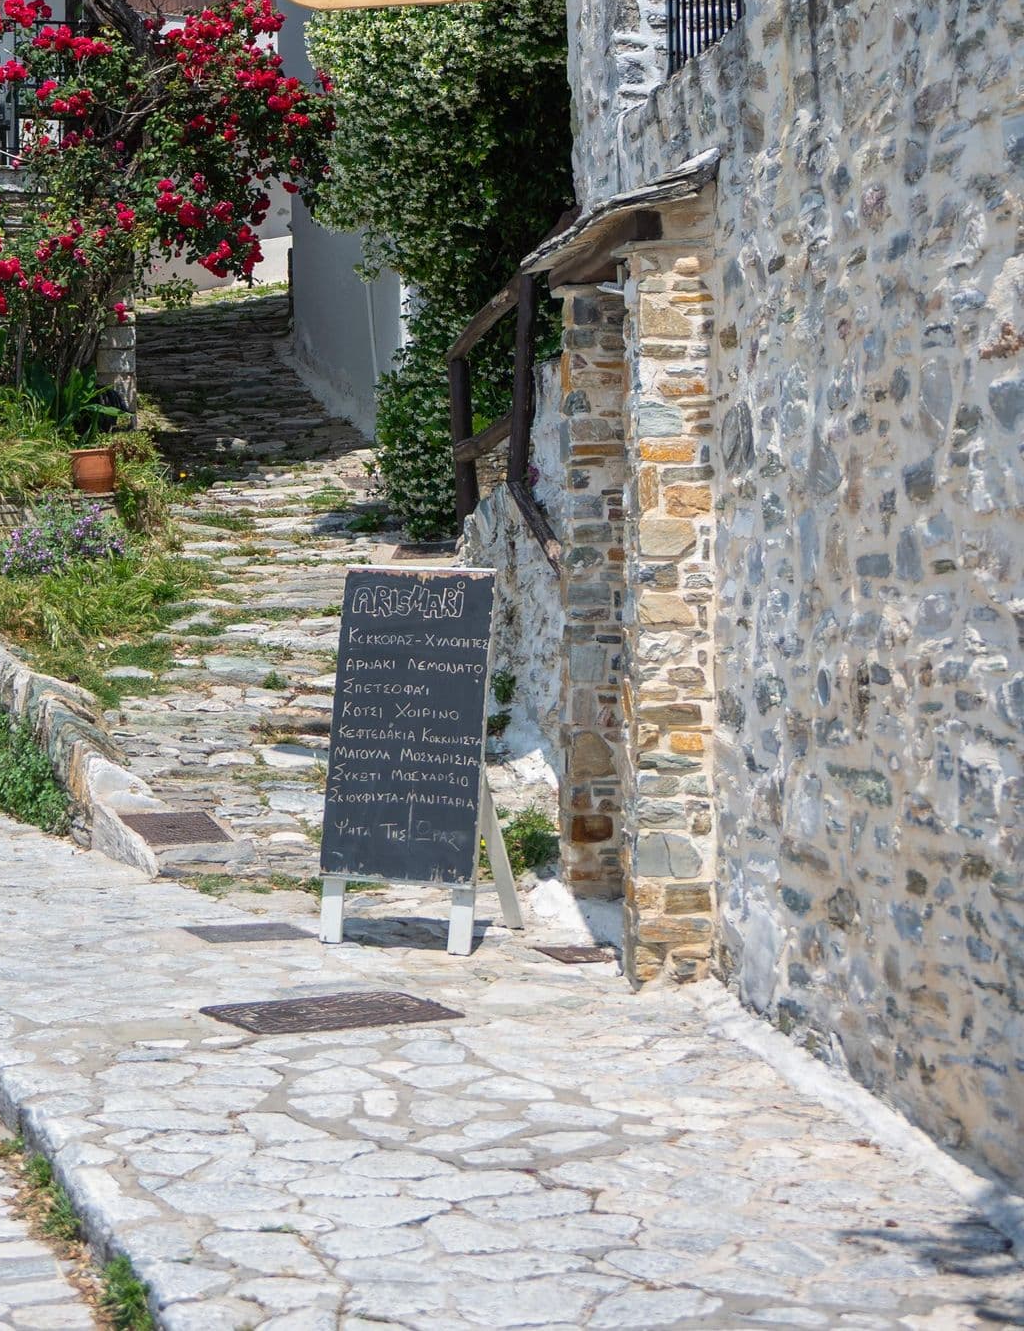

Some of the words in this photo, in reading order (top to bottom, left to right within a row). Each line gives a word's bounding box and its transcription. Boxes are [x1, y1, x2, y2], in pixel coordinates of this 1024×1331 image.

[346, 658, 396, 671] ΑΡΝΑΚΙ
[408, 658, 484, 674] ΛΕΜΟΝΑΤΟ
[342, 701, 383, 718] ΚΟΤΣΙ
[395, 702, 459, 720] ΧΟΙΡΙΝΟ
[421, 727, 483, 746] ΚΟΚΚΙΝΙΣΤΑ
[334, 746, 391, 760] ΜΑΓΟΥΛΑ
[400, 748, 477, 767] ΜΟΣΧΑΡΙΣΙΑ
[332, 763, 381, 781] ΣΥΚΩΤΙ
[392, 769, 469, 787] ΜΟΣΧΑΡΙΣΙΟ
[334, 818, 372, 837] ΨΗΤΑ
